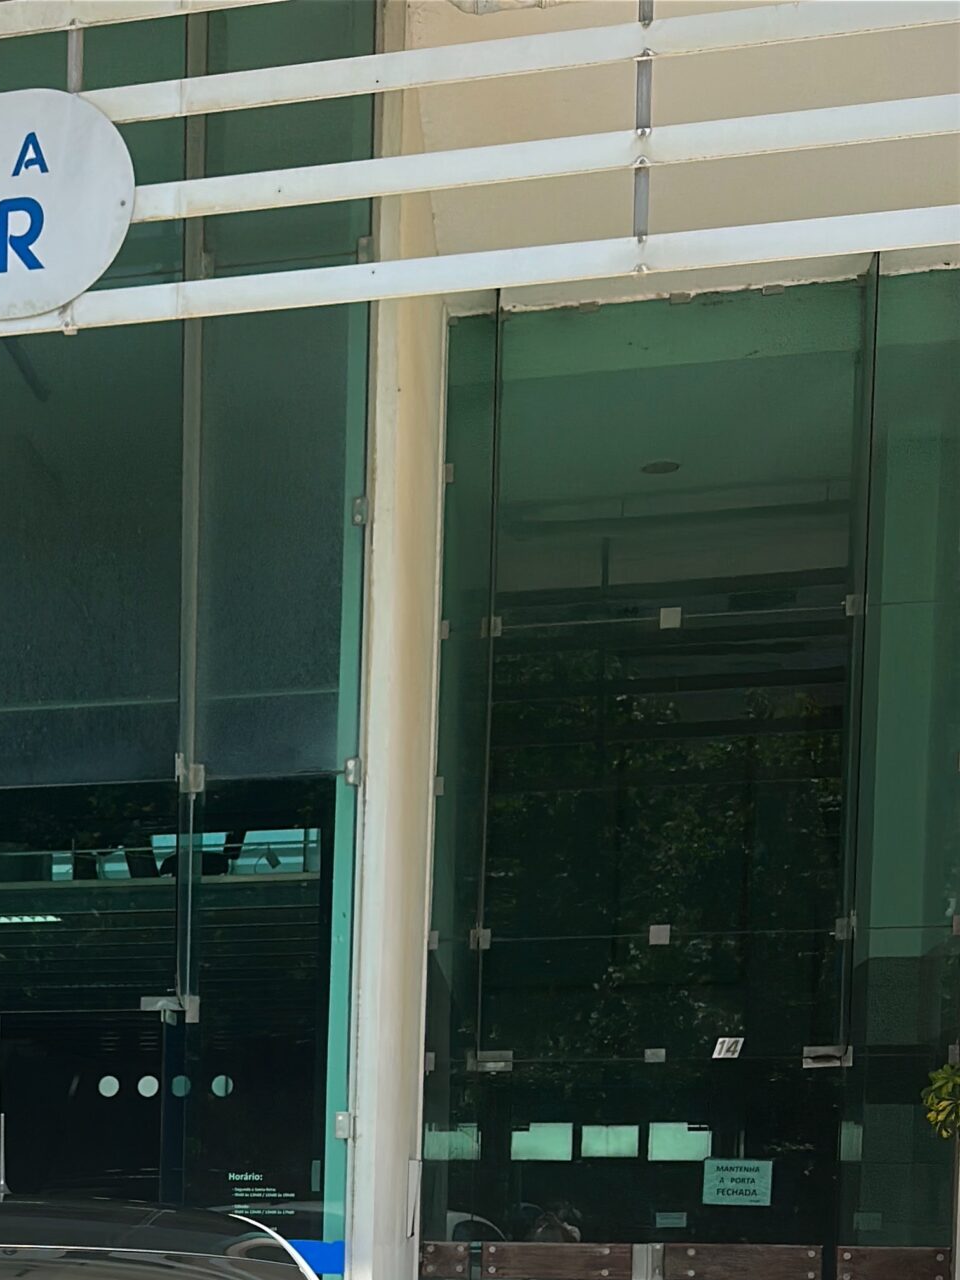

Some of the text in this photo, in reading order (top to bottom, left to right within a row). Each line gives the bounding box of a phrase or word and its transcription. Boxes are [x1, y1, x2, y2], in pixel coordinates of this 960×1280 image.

[717, 1039, 740, 1057] 14
[716, 1165, 760, 1173] MANTENHA
[228, 1172, 263, 1181] Horário:
[716, 1188, 758, 1197] FECHADA
